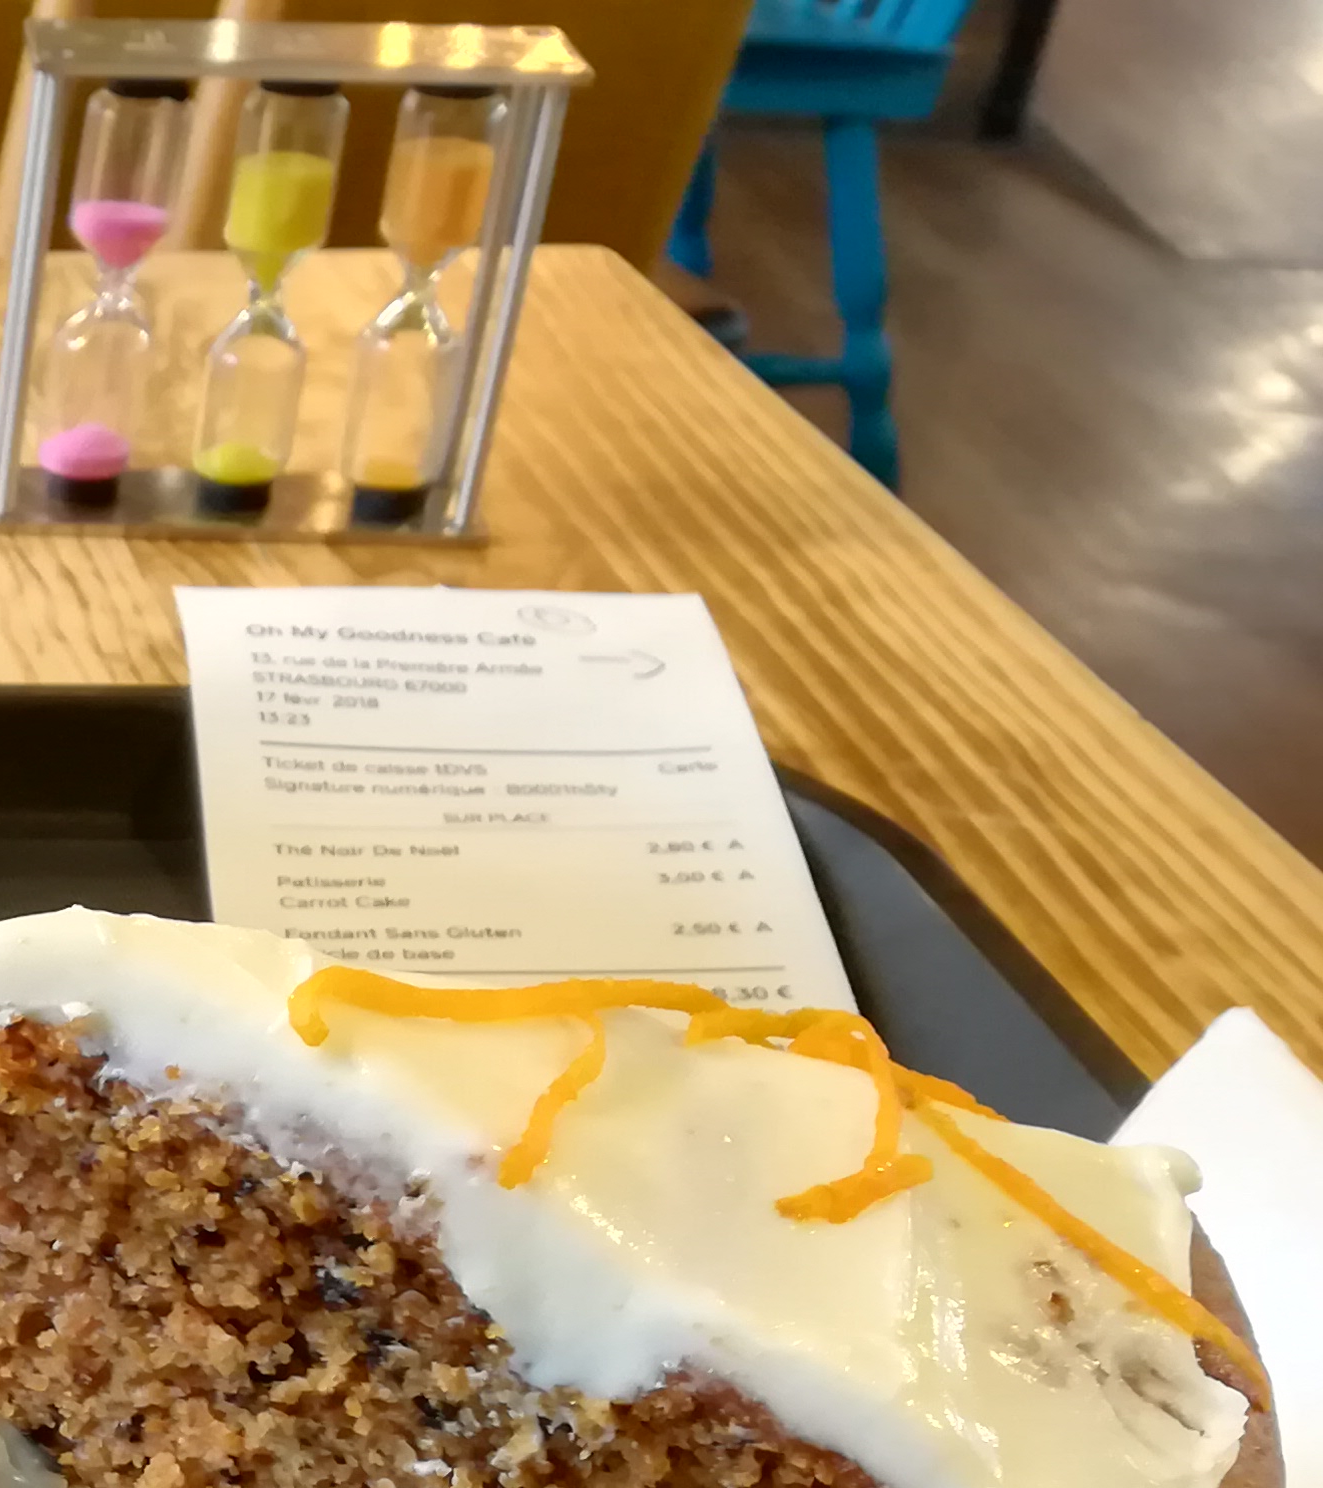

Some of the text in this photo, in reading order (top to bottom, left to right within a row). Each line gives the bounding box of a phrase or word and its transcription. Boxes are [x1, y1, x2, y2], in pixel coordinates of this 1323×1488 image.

[246, 623, 283, 637] Oh
[291, 624, 328, 641] My
[337, 626, 468, 645] Goodness
[283, 655, 316, 668] rue
[323, 654, 347, 669] de
[354, 656, 370, 670] la
[252, 670, 398, 691] STRASBOURG
[333, 695, 379, 710] 2018
[263, 756, 324, 772] Ticket
[332, 759, 358, 774] de
[364, 762, 428, 776] caisse
[264, 777, 485, 797] Signature numérique
[443, 812, 550, 825] SUR PLACE
[321, 844, 363, 858] Noir
[373, 844, 401, 858] De
[728, 838, 744, 851] A
[739, 868, 755, 882] A
[280, 894, 410, 909] Carrot Cake
[285, 925, 522, 941] Fondant Sans Gluten
[756, 919, 773, 934] A
[366, 947, 395, 961] de
[402, 947, 456, 961] base
